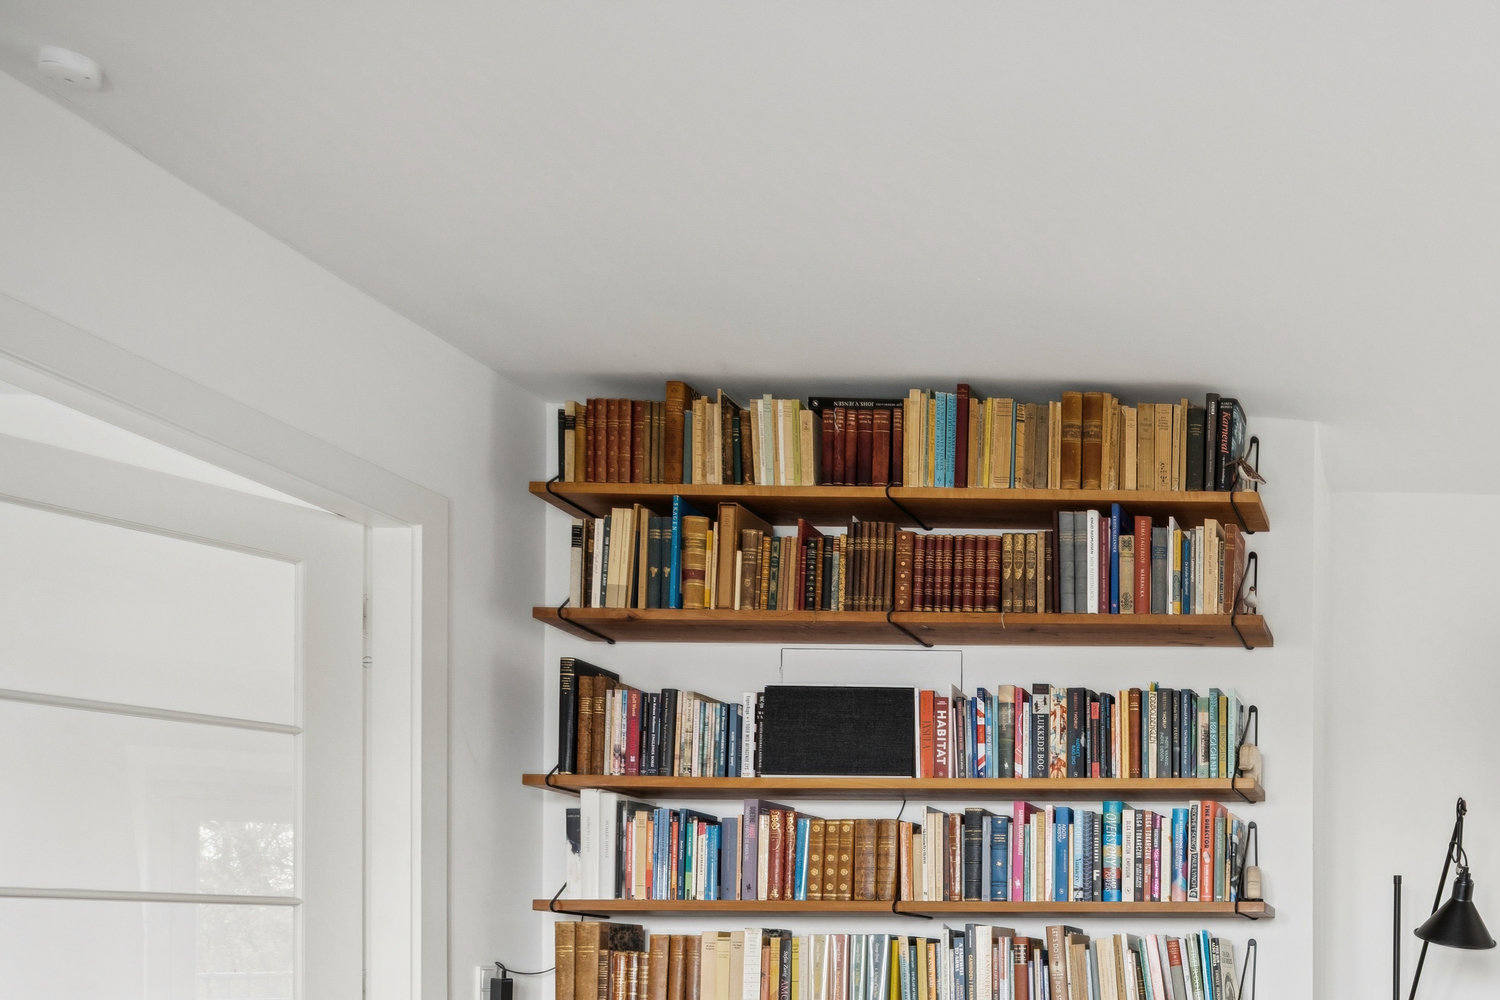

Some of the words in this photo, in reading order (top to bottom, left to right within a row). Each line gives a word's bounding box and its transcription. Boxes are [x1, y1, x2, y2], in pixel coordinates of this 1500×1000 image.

[1221, 411, 1231, 454] Karneval
[922, 720, 931, 749] INSULA
[937, 710, 946, 765] HABITAT
[1106, 813, 1116, 866] OVERSTORY
[1053, 944, 1058, 952] DO
